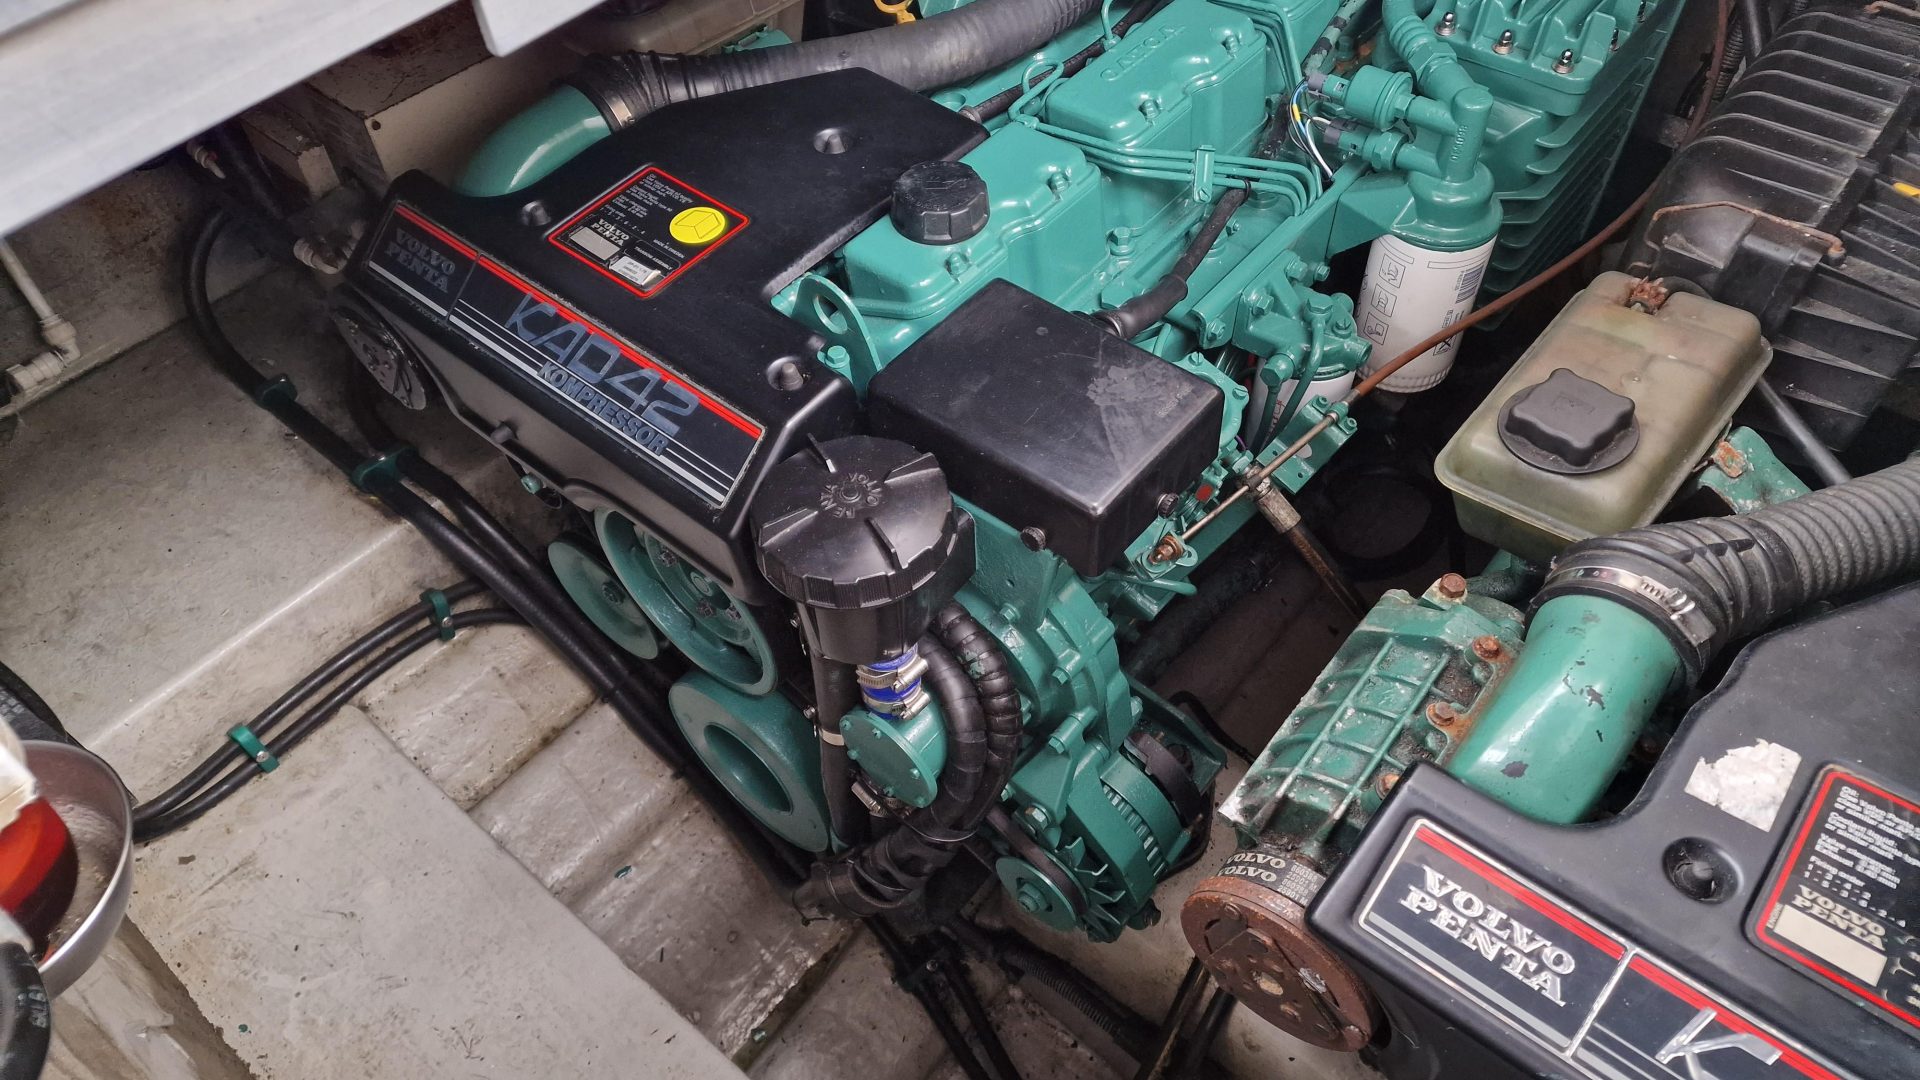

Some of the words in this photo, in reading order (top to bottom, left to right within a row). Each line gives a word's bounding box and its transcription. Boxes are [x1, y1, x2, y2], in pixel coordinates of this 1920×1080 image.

[591, 223, 625, 247] PENTA
[598, 218, 630, 240] VOLVO
[396, 228, 456, 275] VOLVO
[384, 241, 449, 293] PENTA
[537, 361, 669, 456] KOMPRESSOR
[1841, 786, 1859, 797] Oil:
[1829, 812, 1866, 833] Coolant
[1834, 802, 1846, 810] or
[1846, 808, 1877, 825] similar
[1839, 791, 1858, 803] Use
[1859, 799, 1886, 816] Volvo
[1886, 812, 1914, 830] Penta
[1820, 833, 1846, 850] Valve
[1824, 823, 1837, 831] or
[1837, 829, 1868, 846] similar
[1827, 817, 1846, 829] Use
[1848, 826, 1874, 843] Volvo
[1875, 839, 1902, 857] Penta
[1227, 852, 1286, 869] VOLVO
[1815, 845, 1853, 866] Exhaust
[1810, 855, 1838, 874] Firing
[1838, 871, 1864, 886] order
[1862, 891, 1871, 900] 2
[1422, 864, 1576, 975] VOLVO
[1791, 894, 1886, 951] PENTA
[1798, 884, 1886, 937] VOLVO
[1400, 884, 1567, 1007] PENTA
